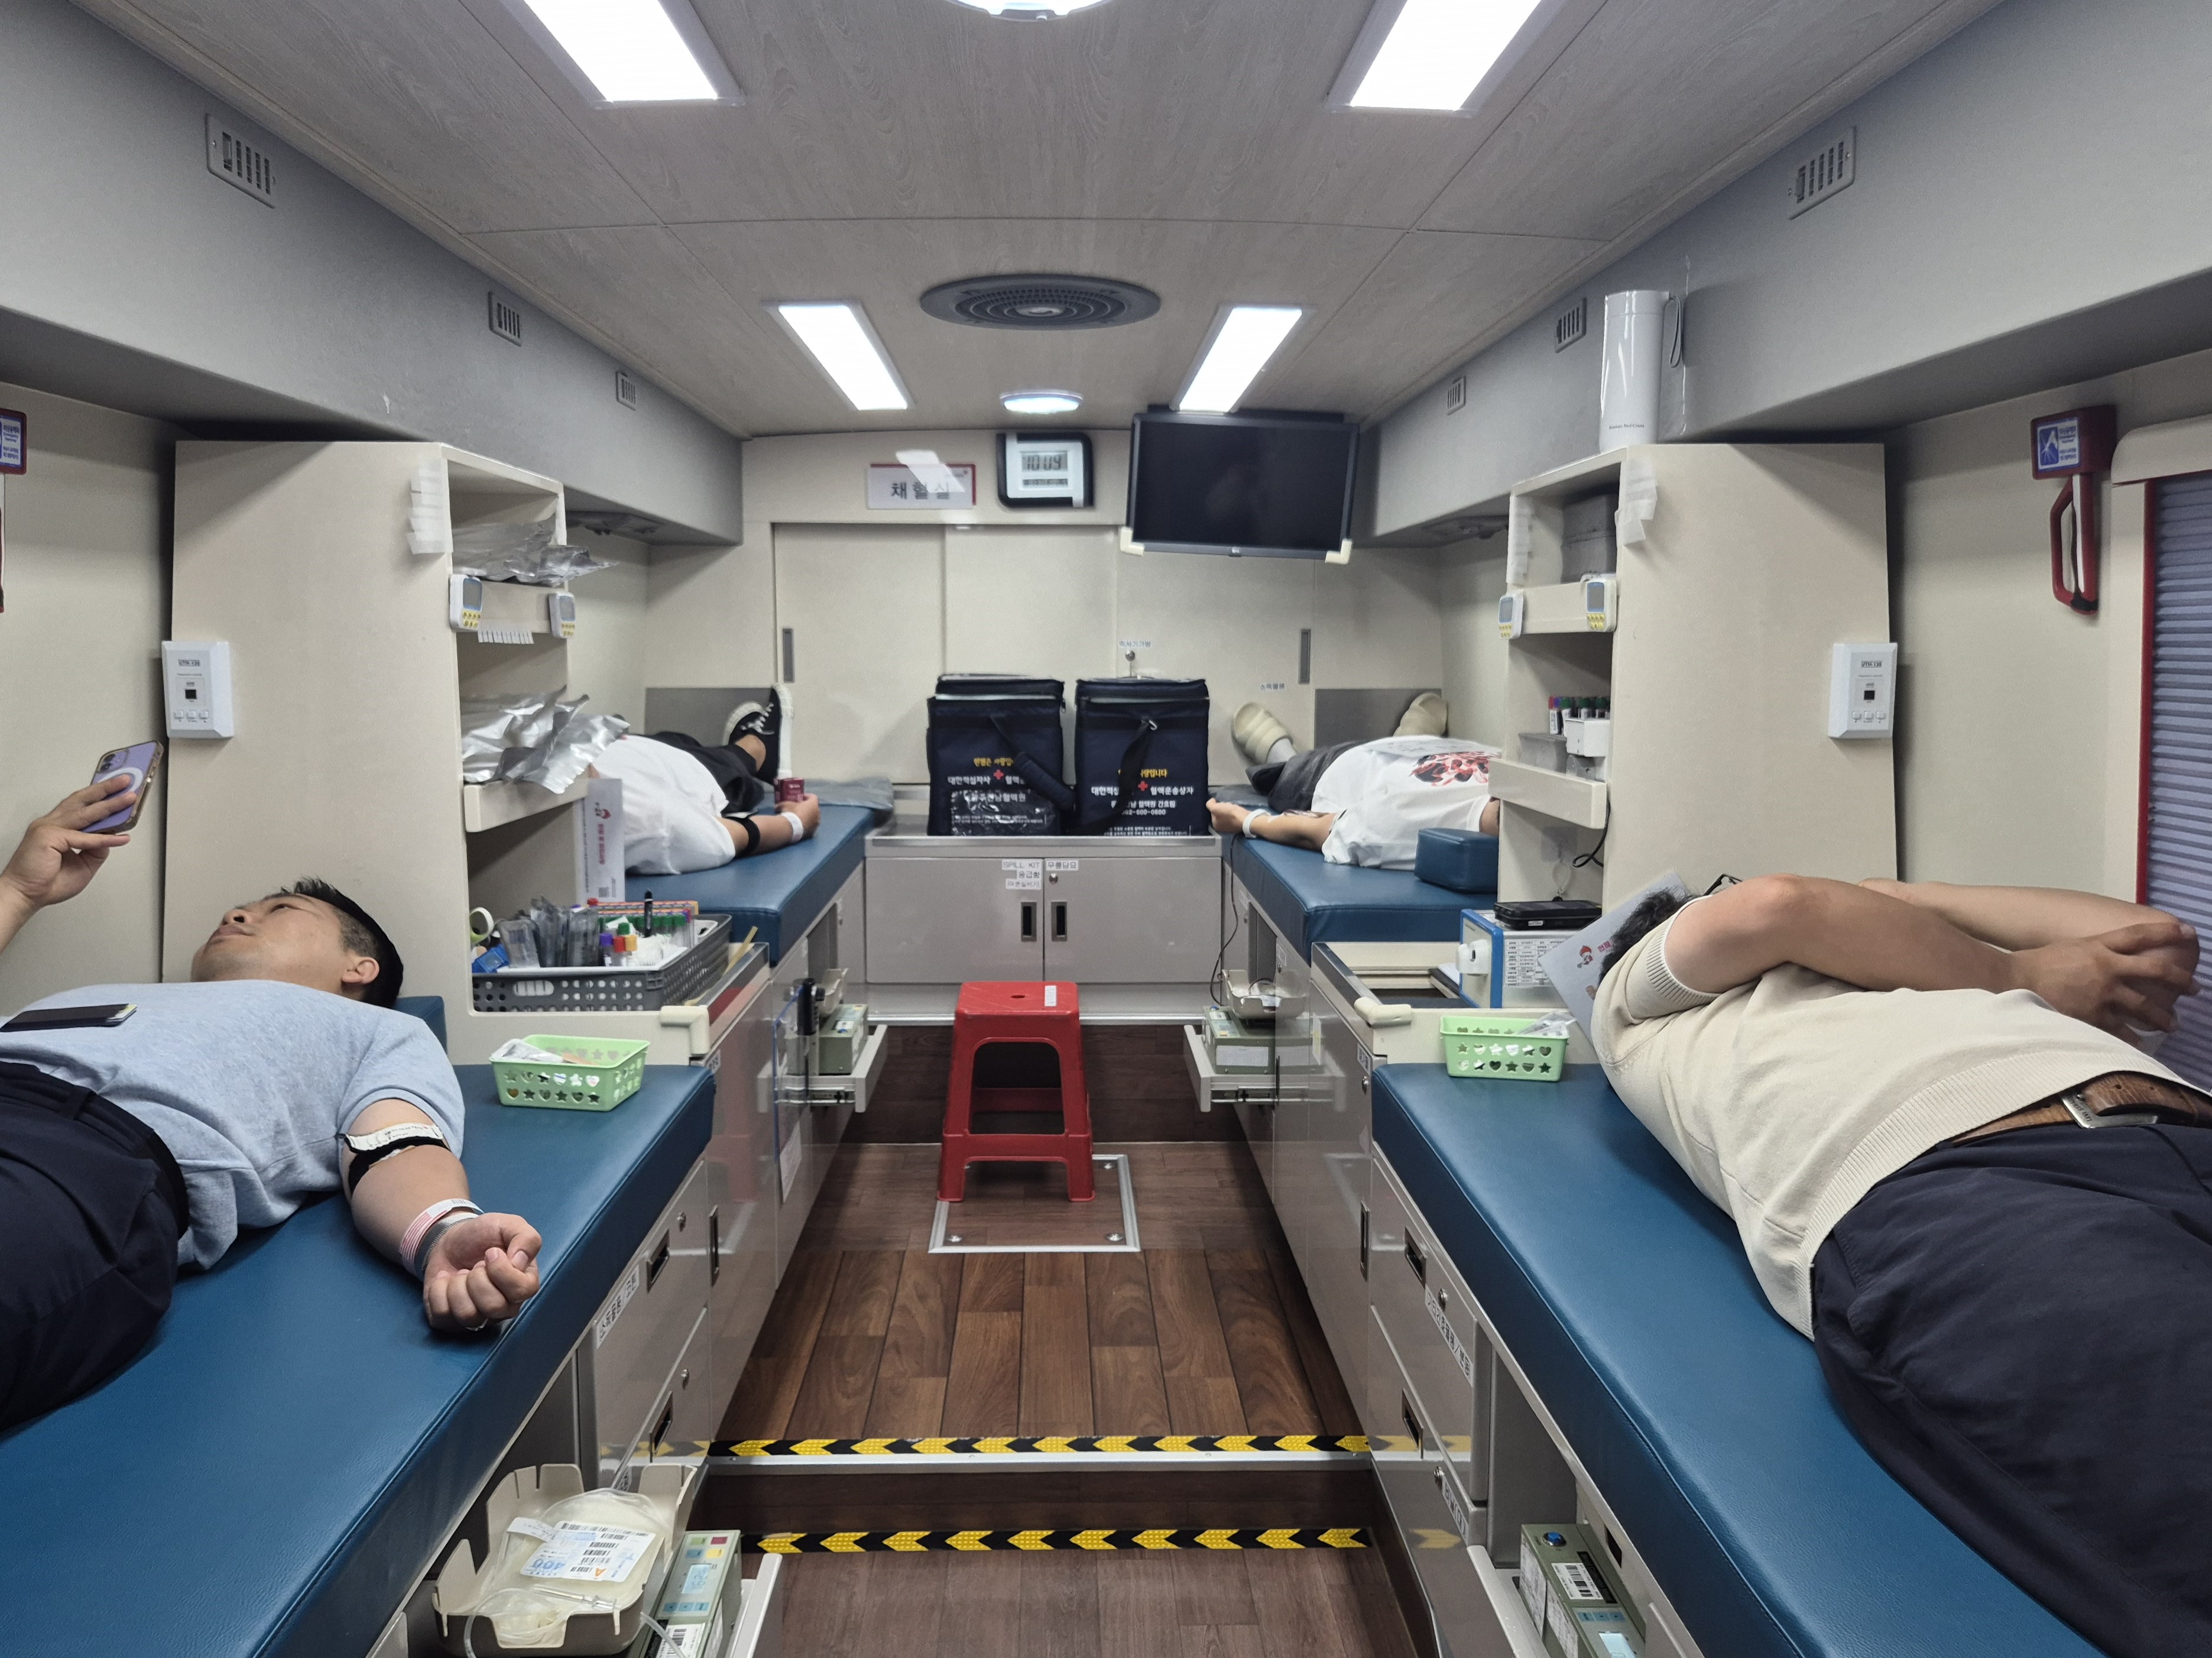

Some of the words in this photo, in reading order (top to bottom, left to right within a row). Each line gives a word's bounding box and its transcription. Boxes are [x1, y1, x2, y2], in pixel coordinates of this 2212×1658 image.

[947, 775, 991, 785] 대한적십자사
[1150, 786, 1194, 796] 혈액운송상자
[1157, 800, 1176, 809] 간호팀
[595, 1567, 606, 1577] A
